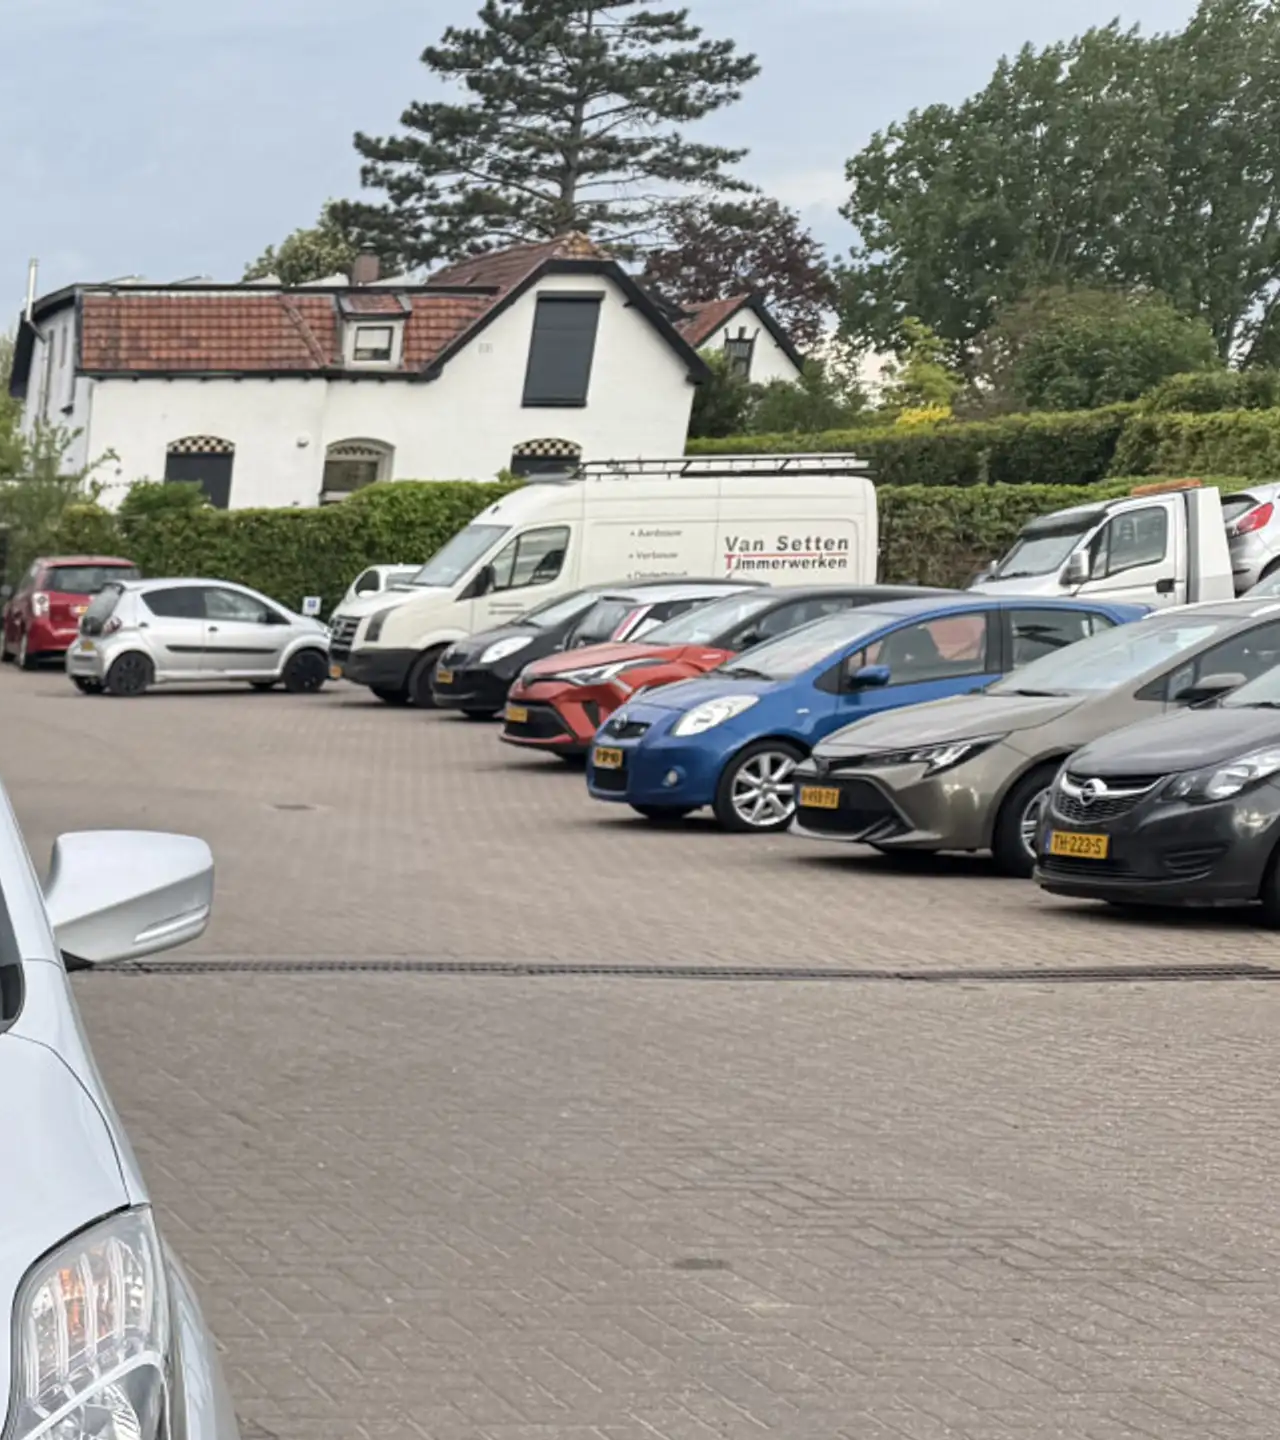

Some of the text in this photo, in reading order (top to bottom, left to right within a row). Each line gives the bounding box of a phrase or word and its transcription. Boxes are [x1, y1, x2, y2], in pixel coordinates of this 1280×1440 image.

[725, 535, 849, 552] Van Setten
[724, 552, 848, 570] Timmerwerken
[1054, 834, 1103, 854] TH-223-S
